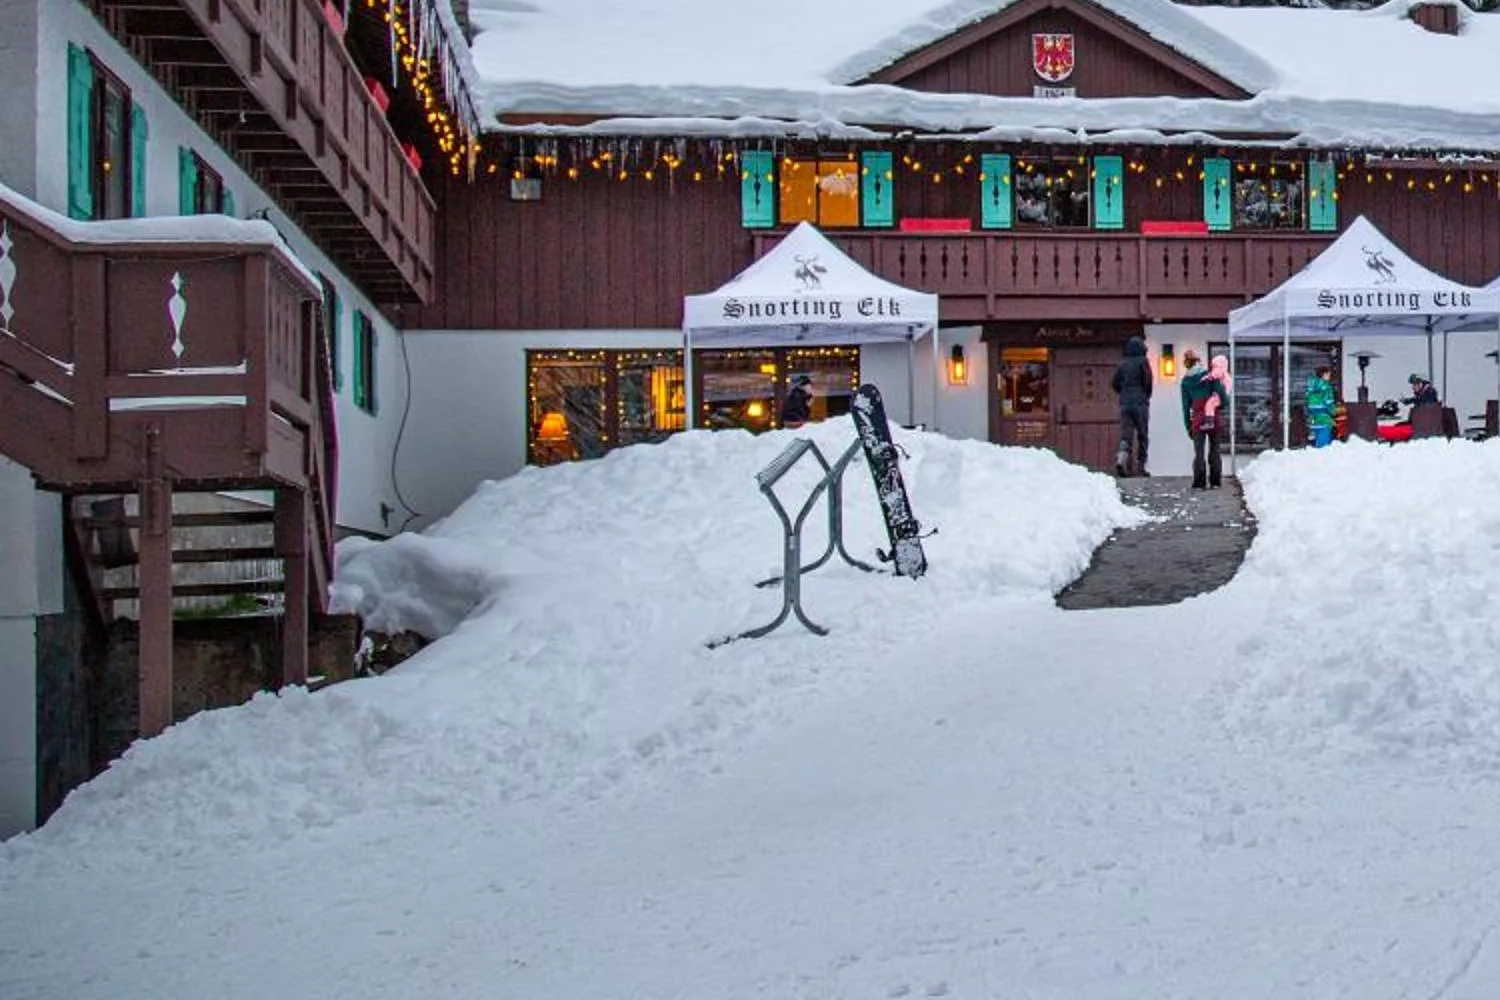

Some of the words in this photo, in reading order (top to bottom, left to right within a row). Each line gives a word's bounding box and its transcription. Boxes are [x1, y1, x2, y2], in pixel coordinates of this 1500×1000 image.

[723, 298, 842, 318] Snorting
[857, 297, 901, 316] Elk
[1317, 290, 1421, 310] Snorting
[1433, 292, 1472, 307] Elk
